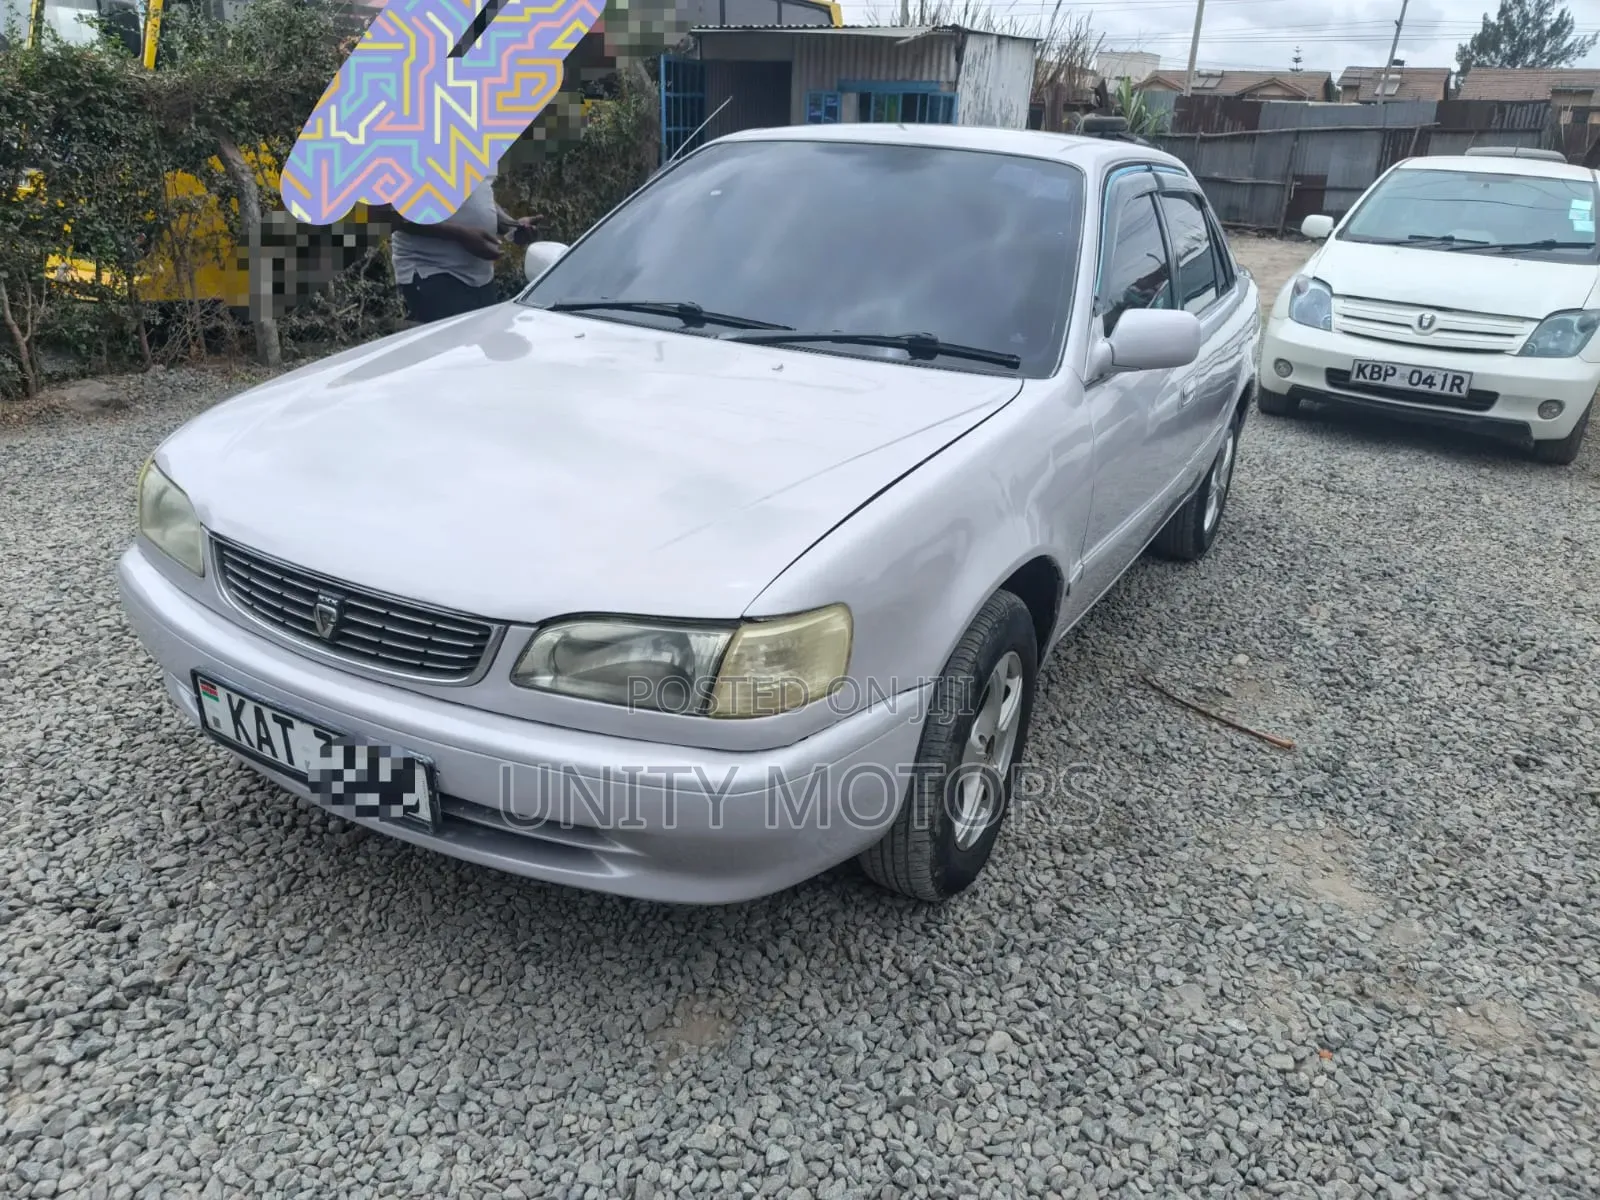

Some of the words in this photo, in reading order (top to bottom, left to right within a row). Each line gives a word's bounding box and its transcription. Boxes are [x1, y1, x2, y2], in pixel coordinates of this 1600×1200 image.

[1355, 363, 1397, 382] KBP
[1408, 370, 1465, 393] 041R
[225, 692, 295, 766] KAT
